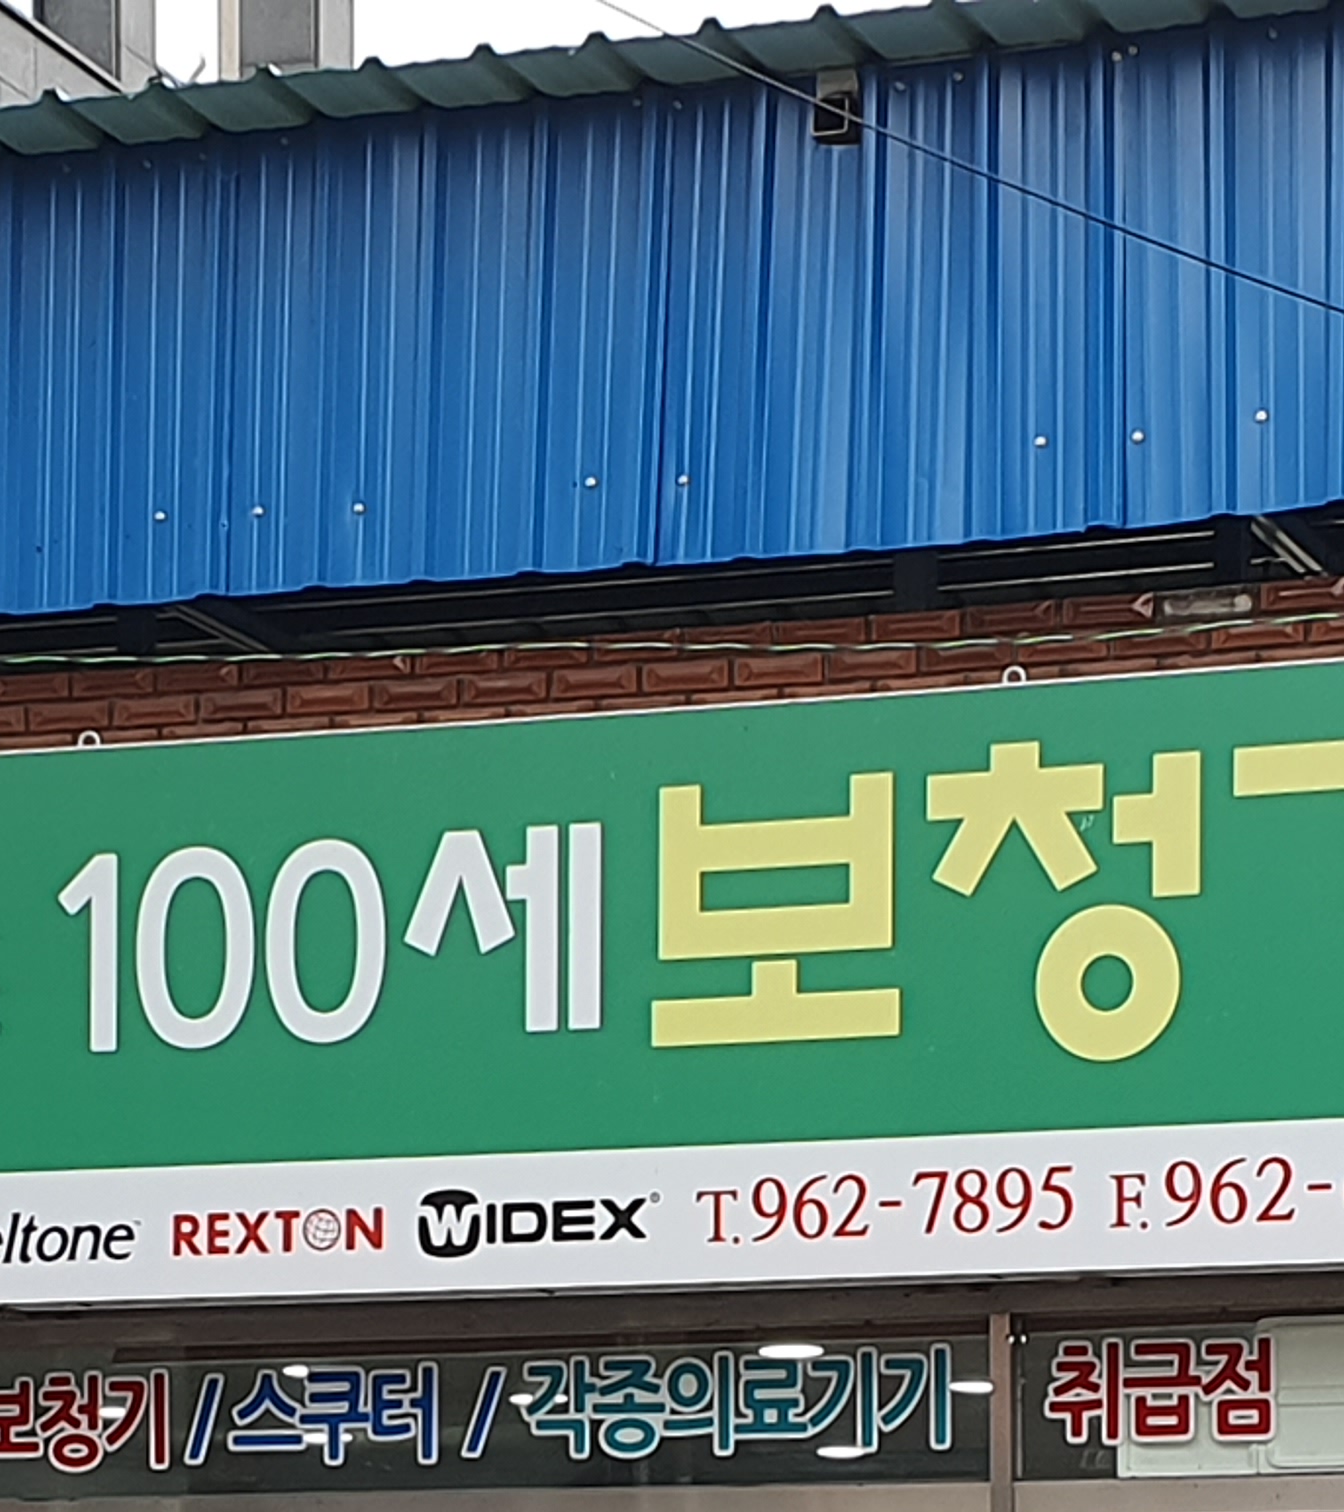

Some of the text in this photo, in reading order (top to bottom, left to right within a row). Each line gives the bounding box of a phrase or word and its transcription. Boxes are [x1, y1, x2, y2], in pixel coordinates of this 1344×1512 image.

[57, 822, 602, 1053] 100세
[172, 1207, 386, 1257] REXTON
[417, 1190, 649, 1258] WIDEX
[696, 1165, 1075, 1244] T.962-7895
[227, 1361, 438, 1465] 스쿠터
[521, 1342, 952, 1460] 각종의료기기
[1045, 1335, 1277, 1447] 취급점
